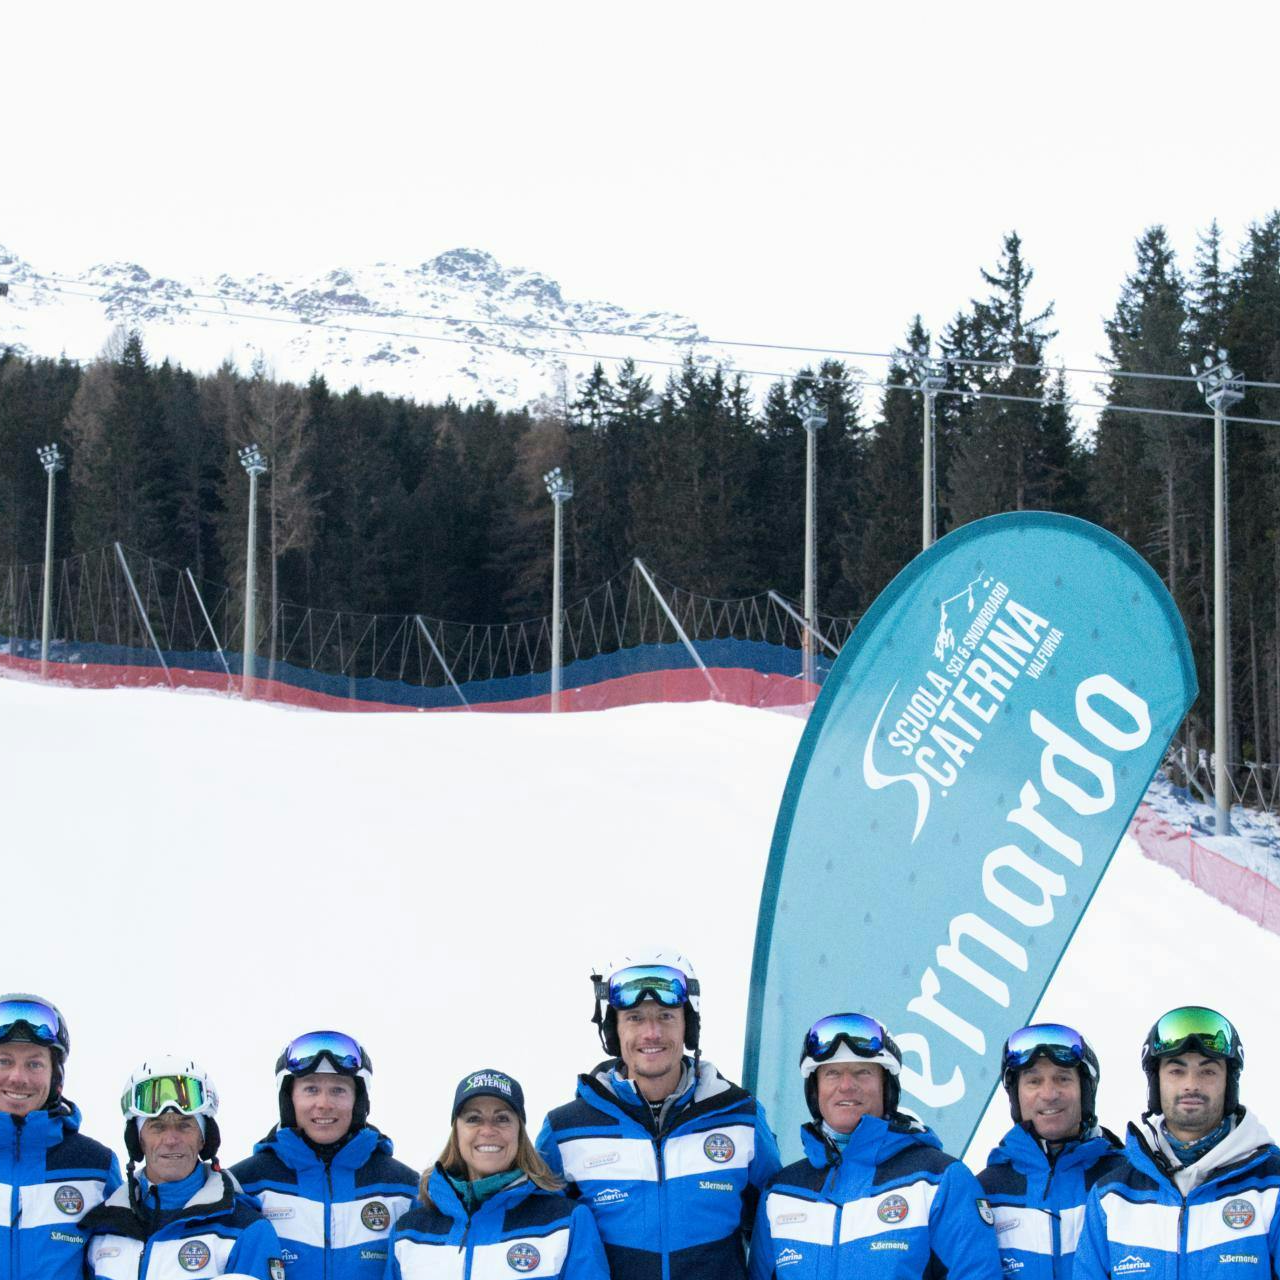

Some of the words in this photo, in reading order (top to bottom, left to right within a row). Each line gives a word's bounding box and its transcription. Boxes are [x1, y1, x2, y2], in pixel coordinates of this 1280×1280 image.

[963, 581, 1010, 647] SNOWBOARD
[957, 645, 970, 659] &
[1025, 627, 1064, 680] VALFURVA
[946, 654, 966, 677] SCI
[888, 670, 953, 756] SCUOLA
[898, 674, 1151, 1128] ernardo
[699, 1181, 733, 1191] S.Bernardo
[51, 1231, 84, 1245] S.Bernardo
[871, 1241, 909, 1251] S.Bernardo
[1219, 1254, 1258, 1264] S.Bernardo
